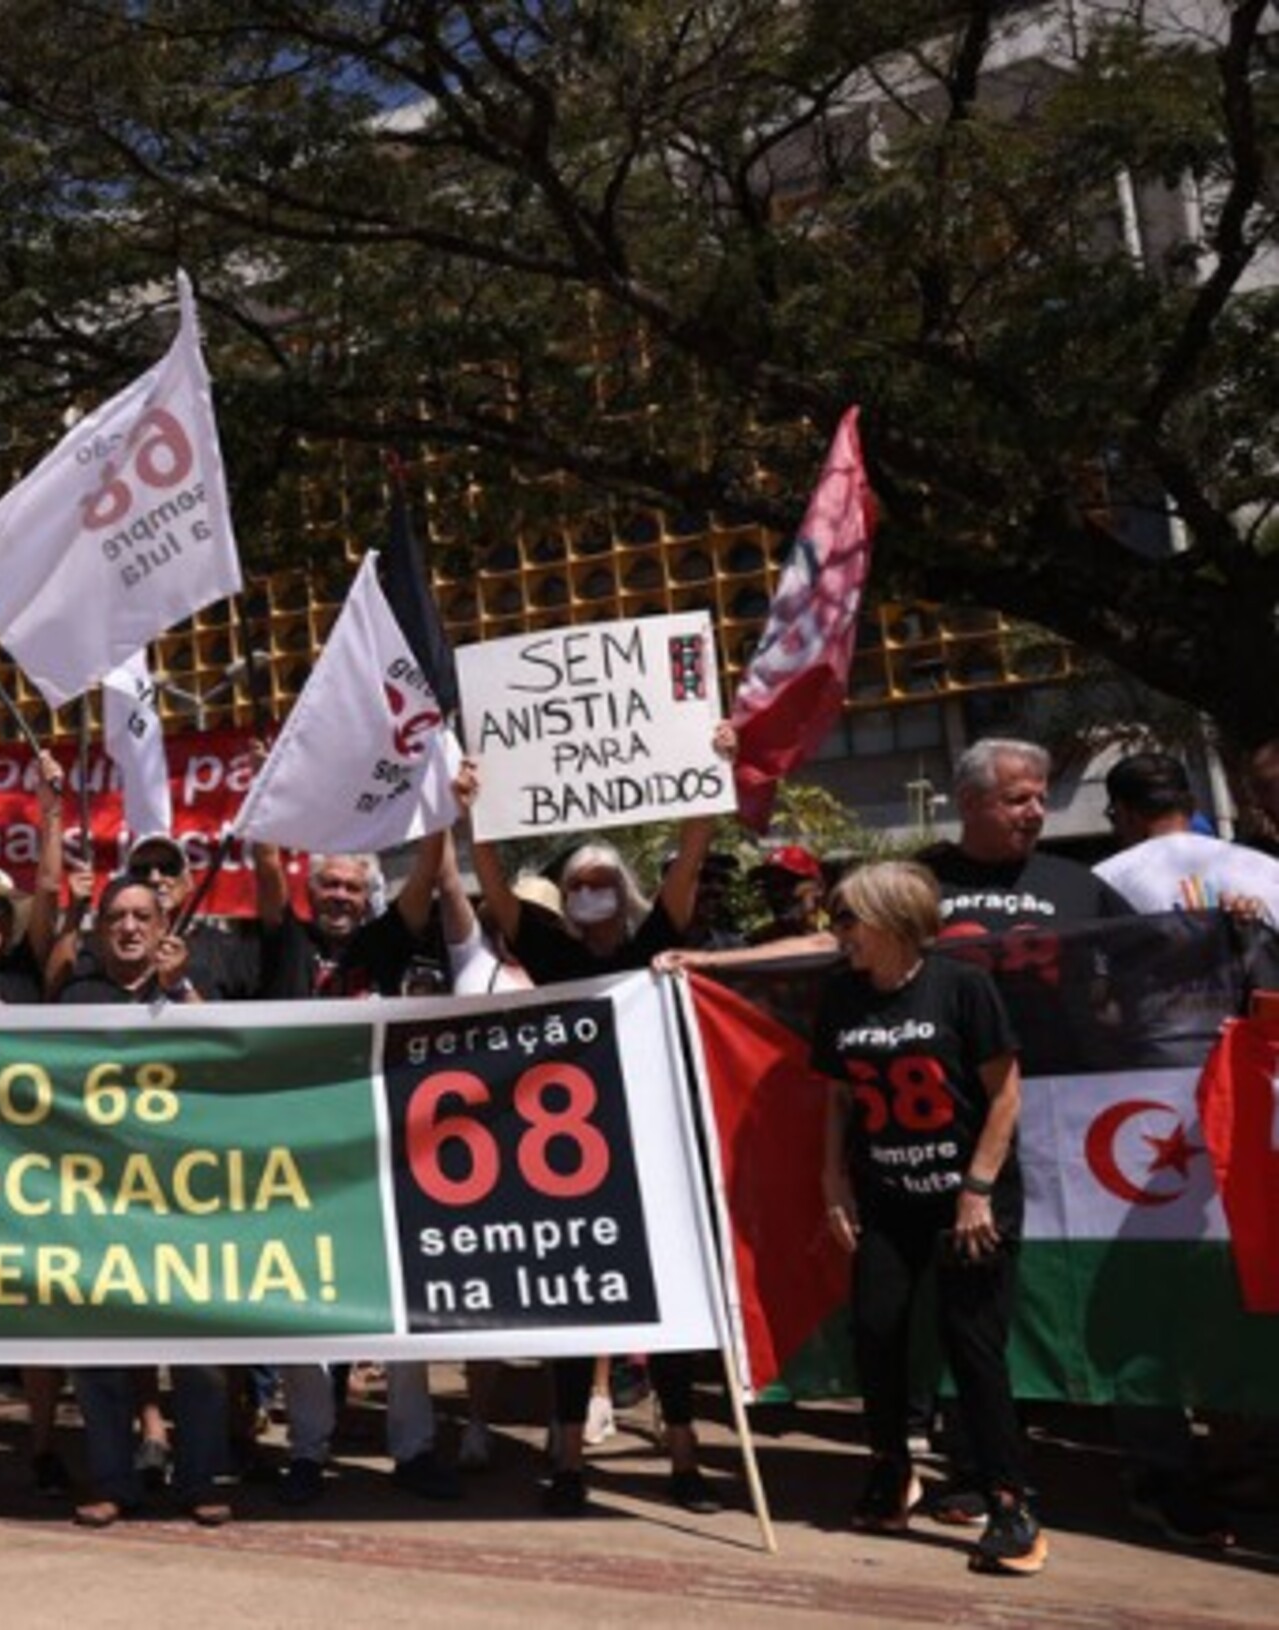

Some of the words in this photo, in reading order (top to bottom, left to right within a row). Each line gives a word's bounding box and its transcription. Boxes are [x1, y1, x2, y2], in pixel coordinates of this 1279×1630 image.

[507, 626, 646, 693] SEM
[478, 688, 652, 754] ANISTIA
[184, 754, 253, 806] pa
[553, 731, 650, 774] PARA
[519, 766, 723, 826] BANDIDOS
[407, 1015, 598, 1064] geração
[84, 1062, 180, 1125] 68
[405, 1060, 611, 1207] 68
[420, 1216, 618, 1259] sempre
[426, 1277, 492, 1313] na
[517, 1265, 629, 1308] luta
